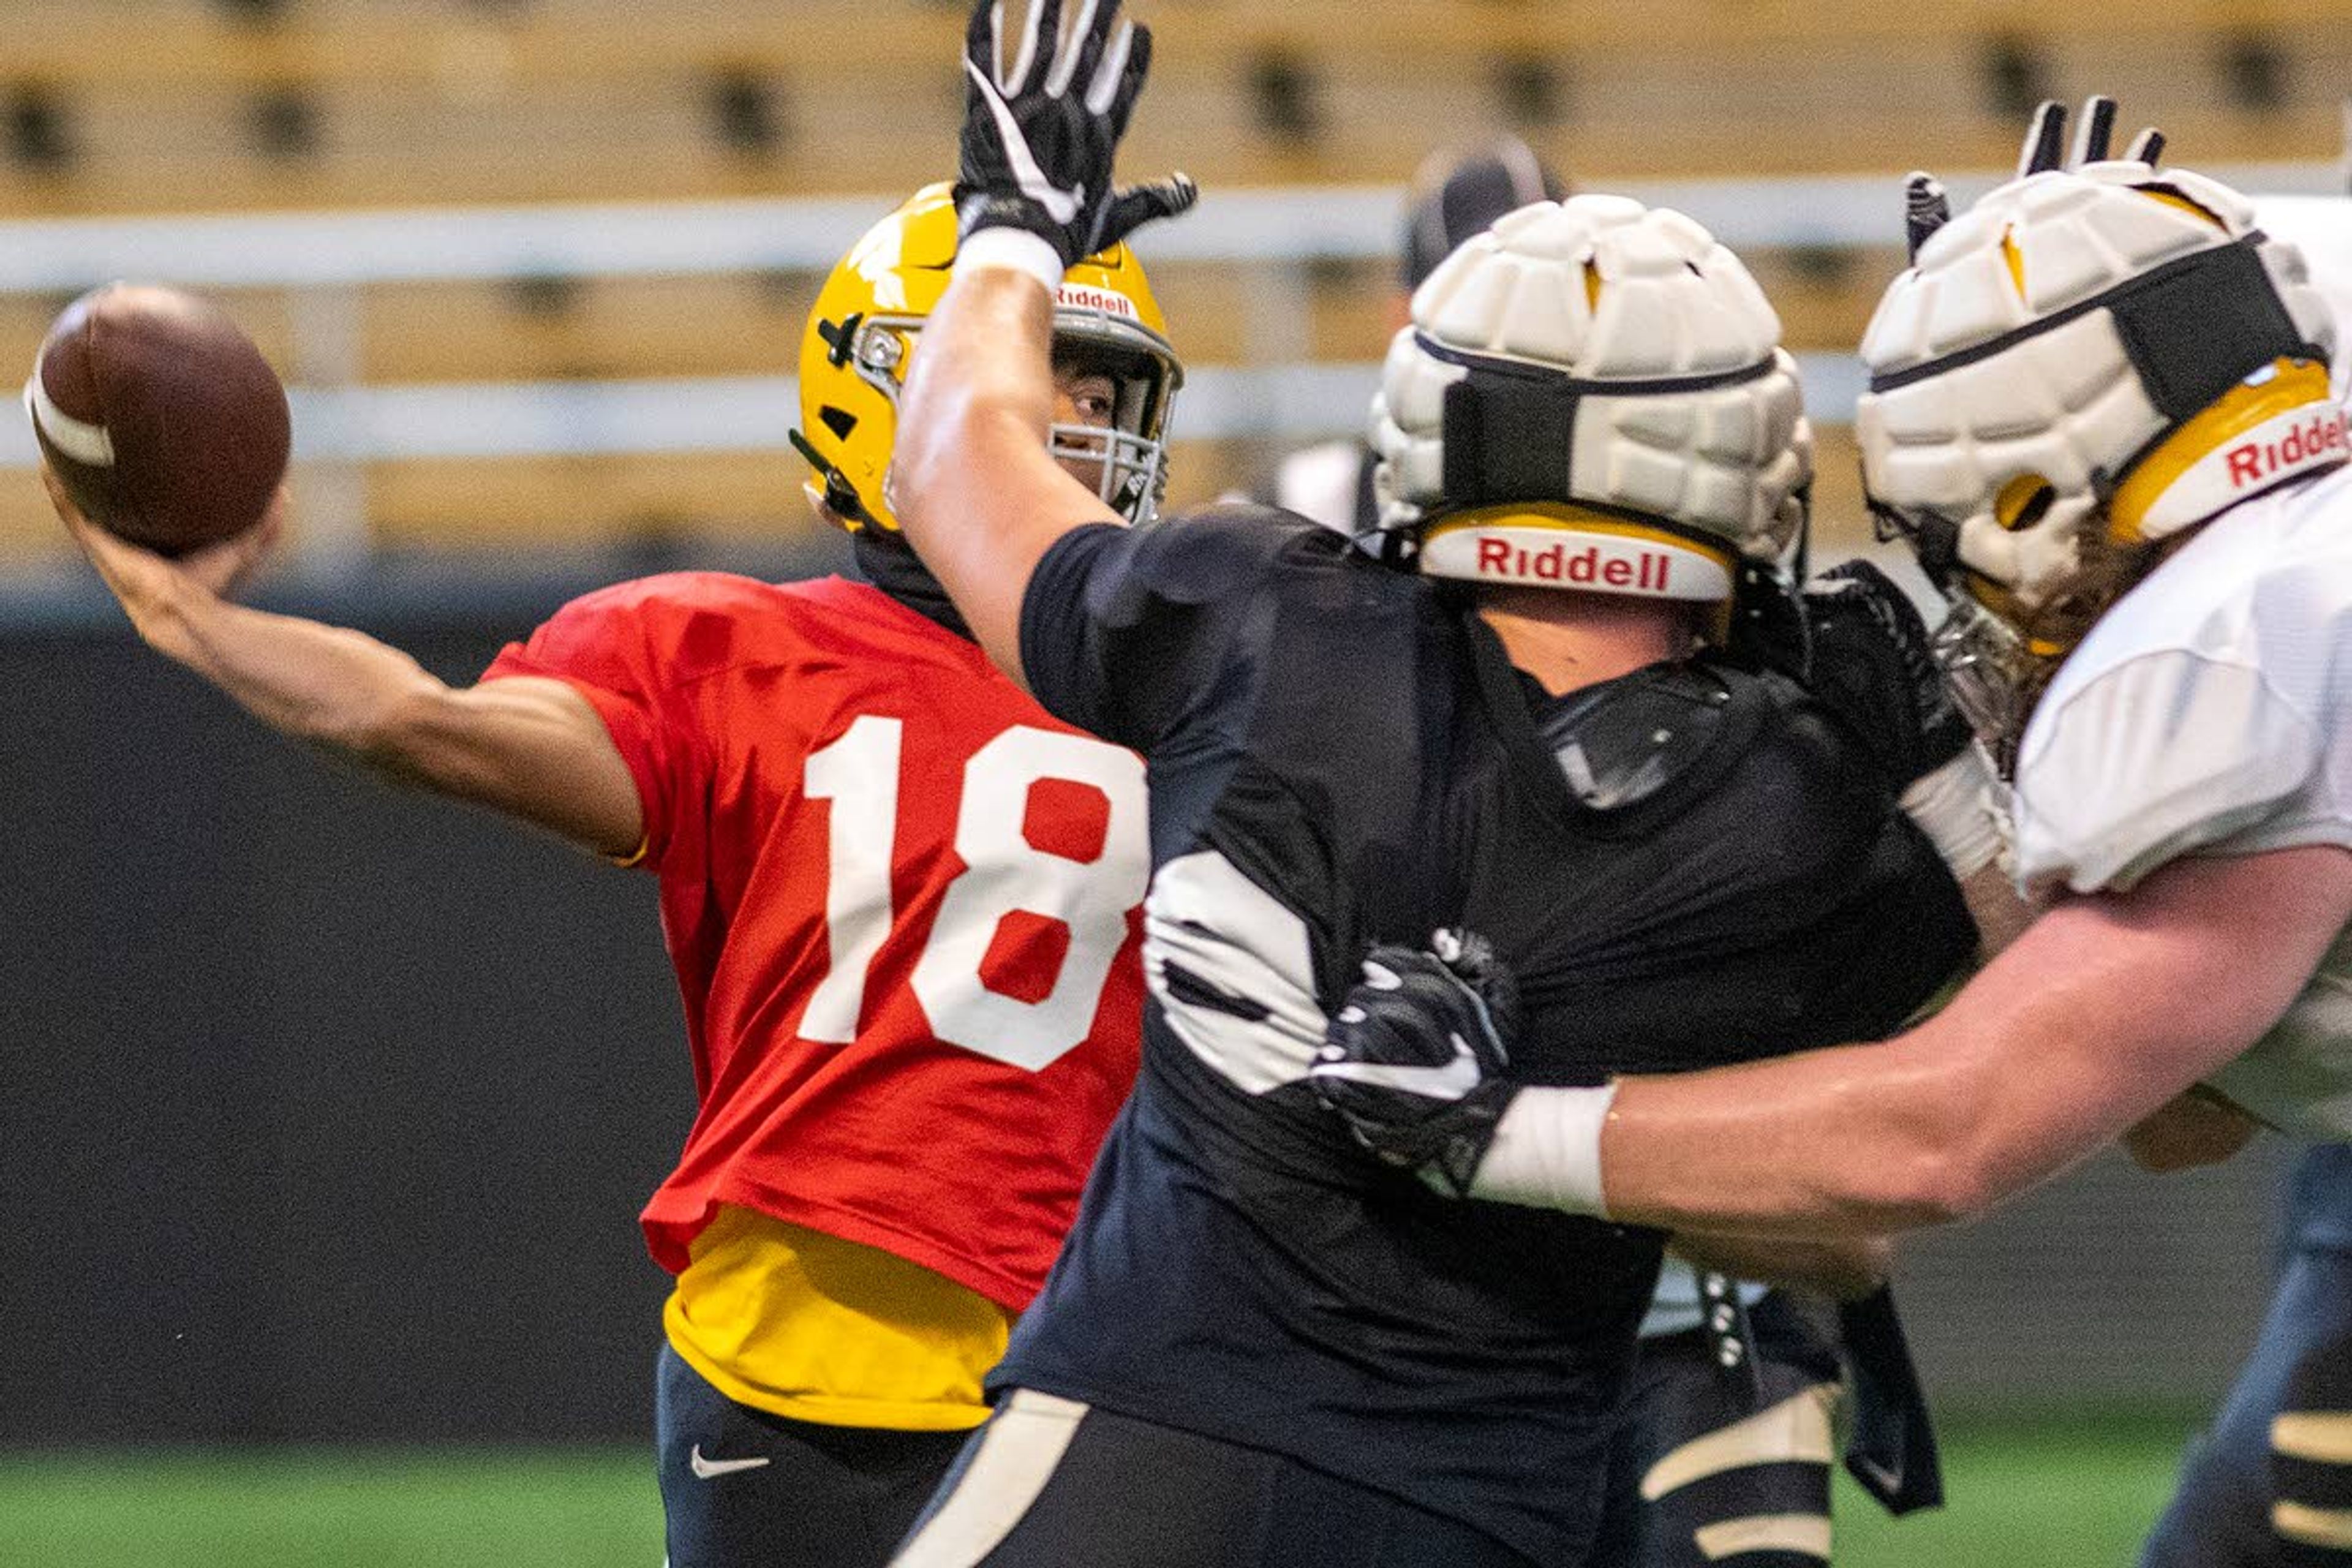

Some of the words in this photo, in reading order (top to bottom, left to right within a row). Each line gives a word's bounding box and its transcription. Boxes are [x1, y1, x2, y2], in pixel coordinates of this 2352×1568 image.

[2225, 409, 2350, 488] Riddel
[1477, 537, 1672, 591] Riddell
[796, 714, 1152, 1073] 18
